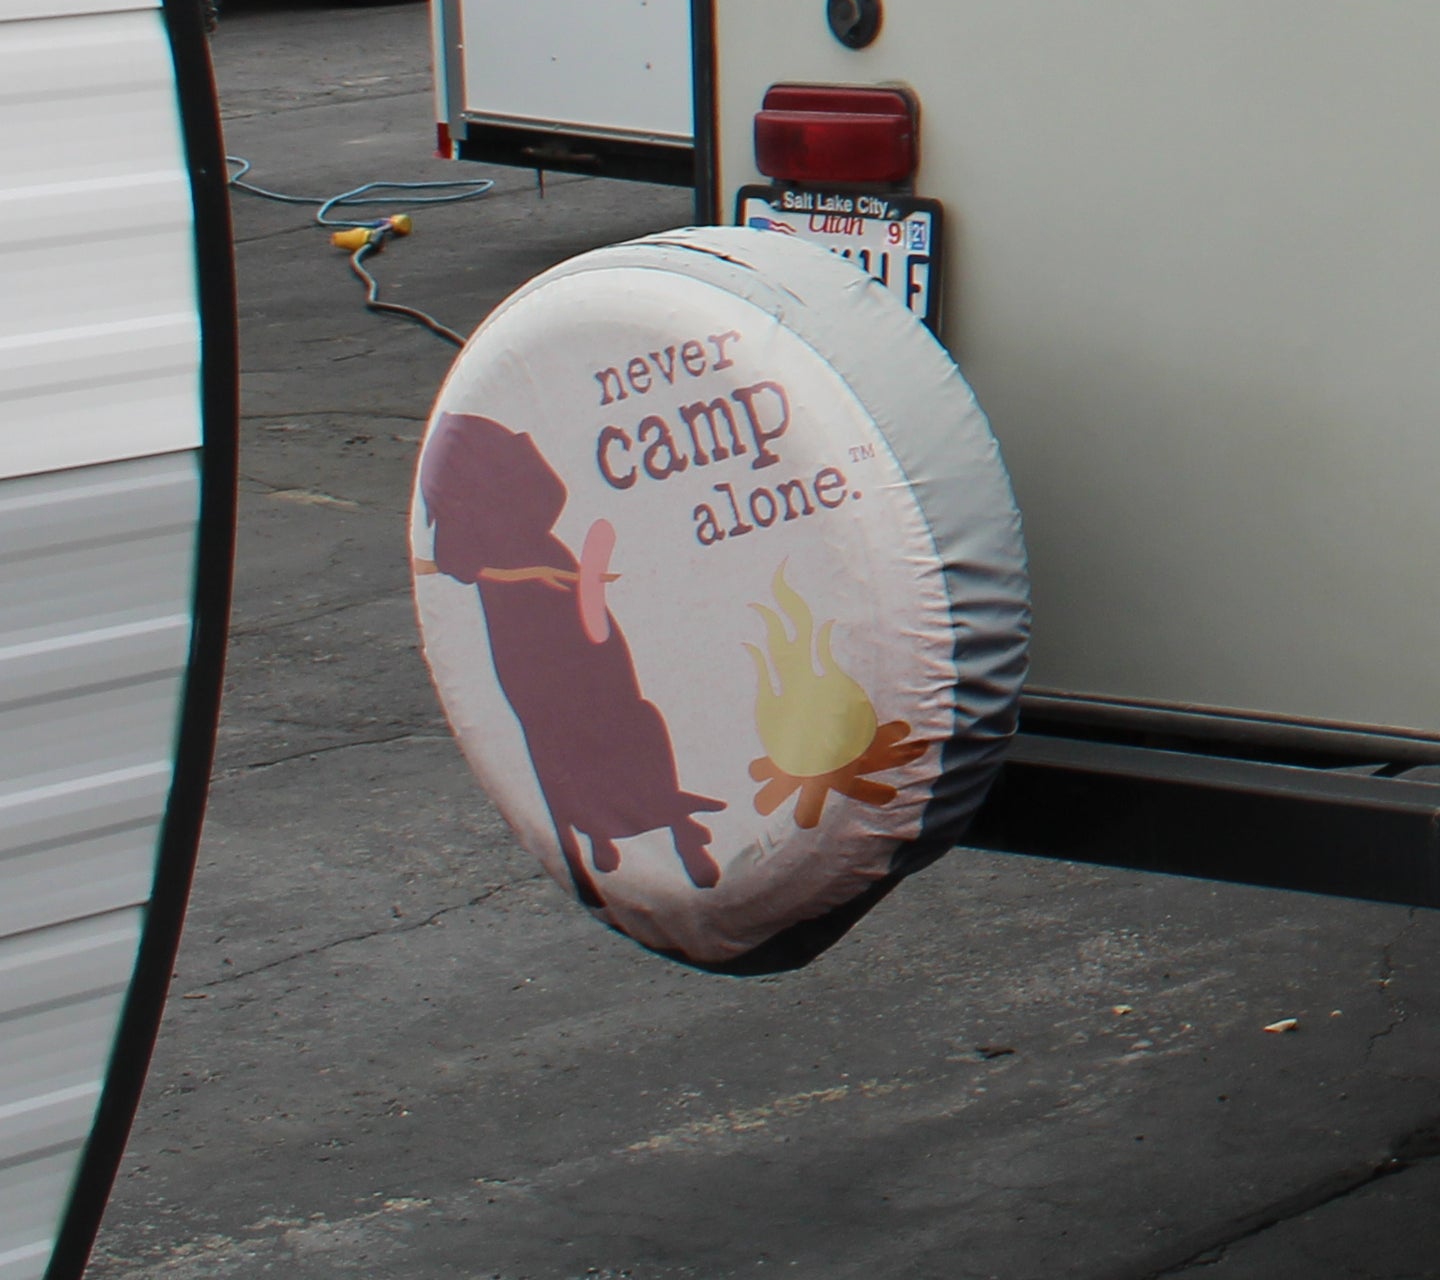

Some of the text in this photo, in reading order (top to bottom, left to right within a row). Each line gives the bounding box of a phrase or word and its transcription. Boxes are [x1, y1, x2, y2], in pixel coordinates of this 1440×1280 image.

[783, 191, 889, 217] Salt Lake City
[888, 223, 901, 245] 9
[594, 330, 741, 406] never
[596, 381, 791, 490] camp
[692, 467, 862, 546] alone.
